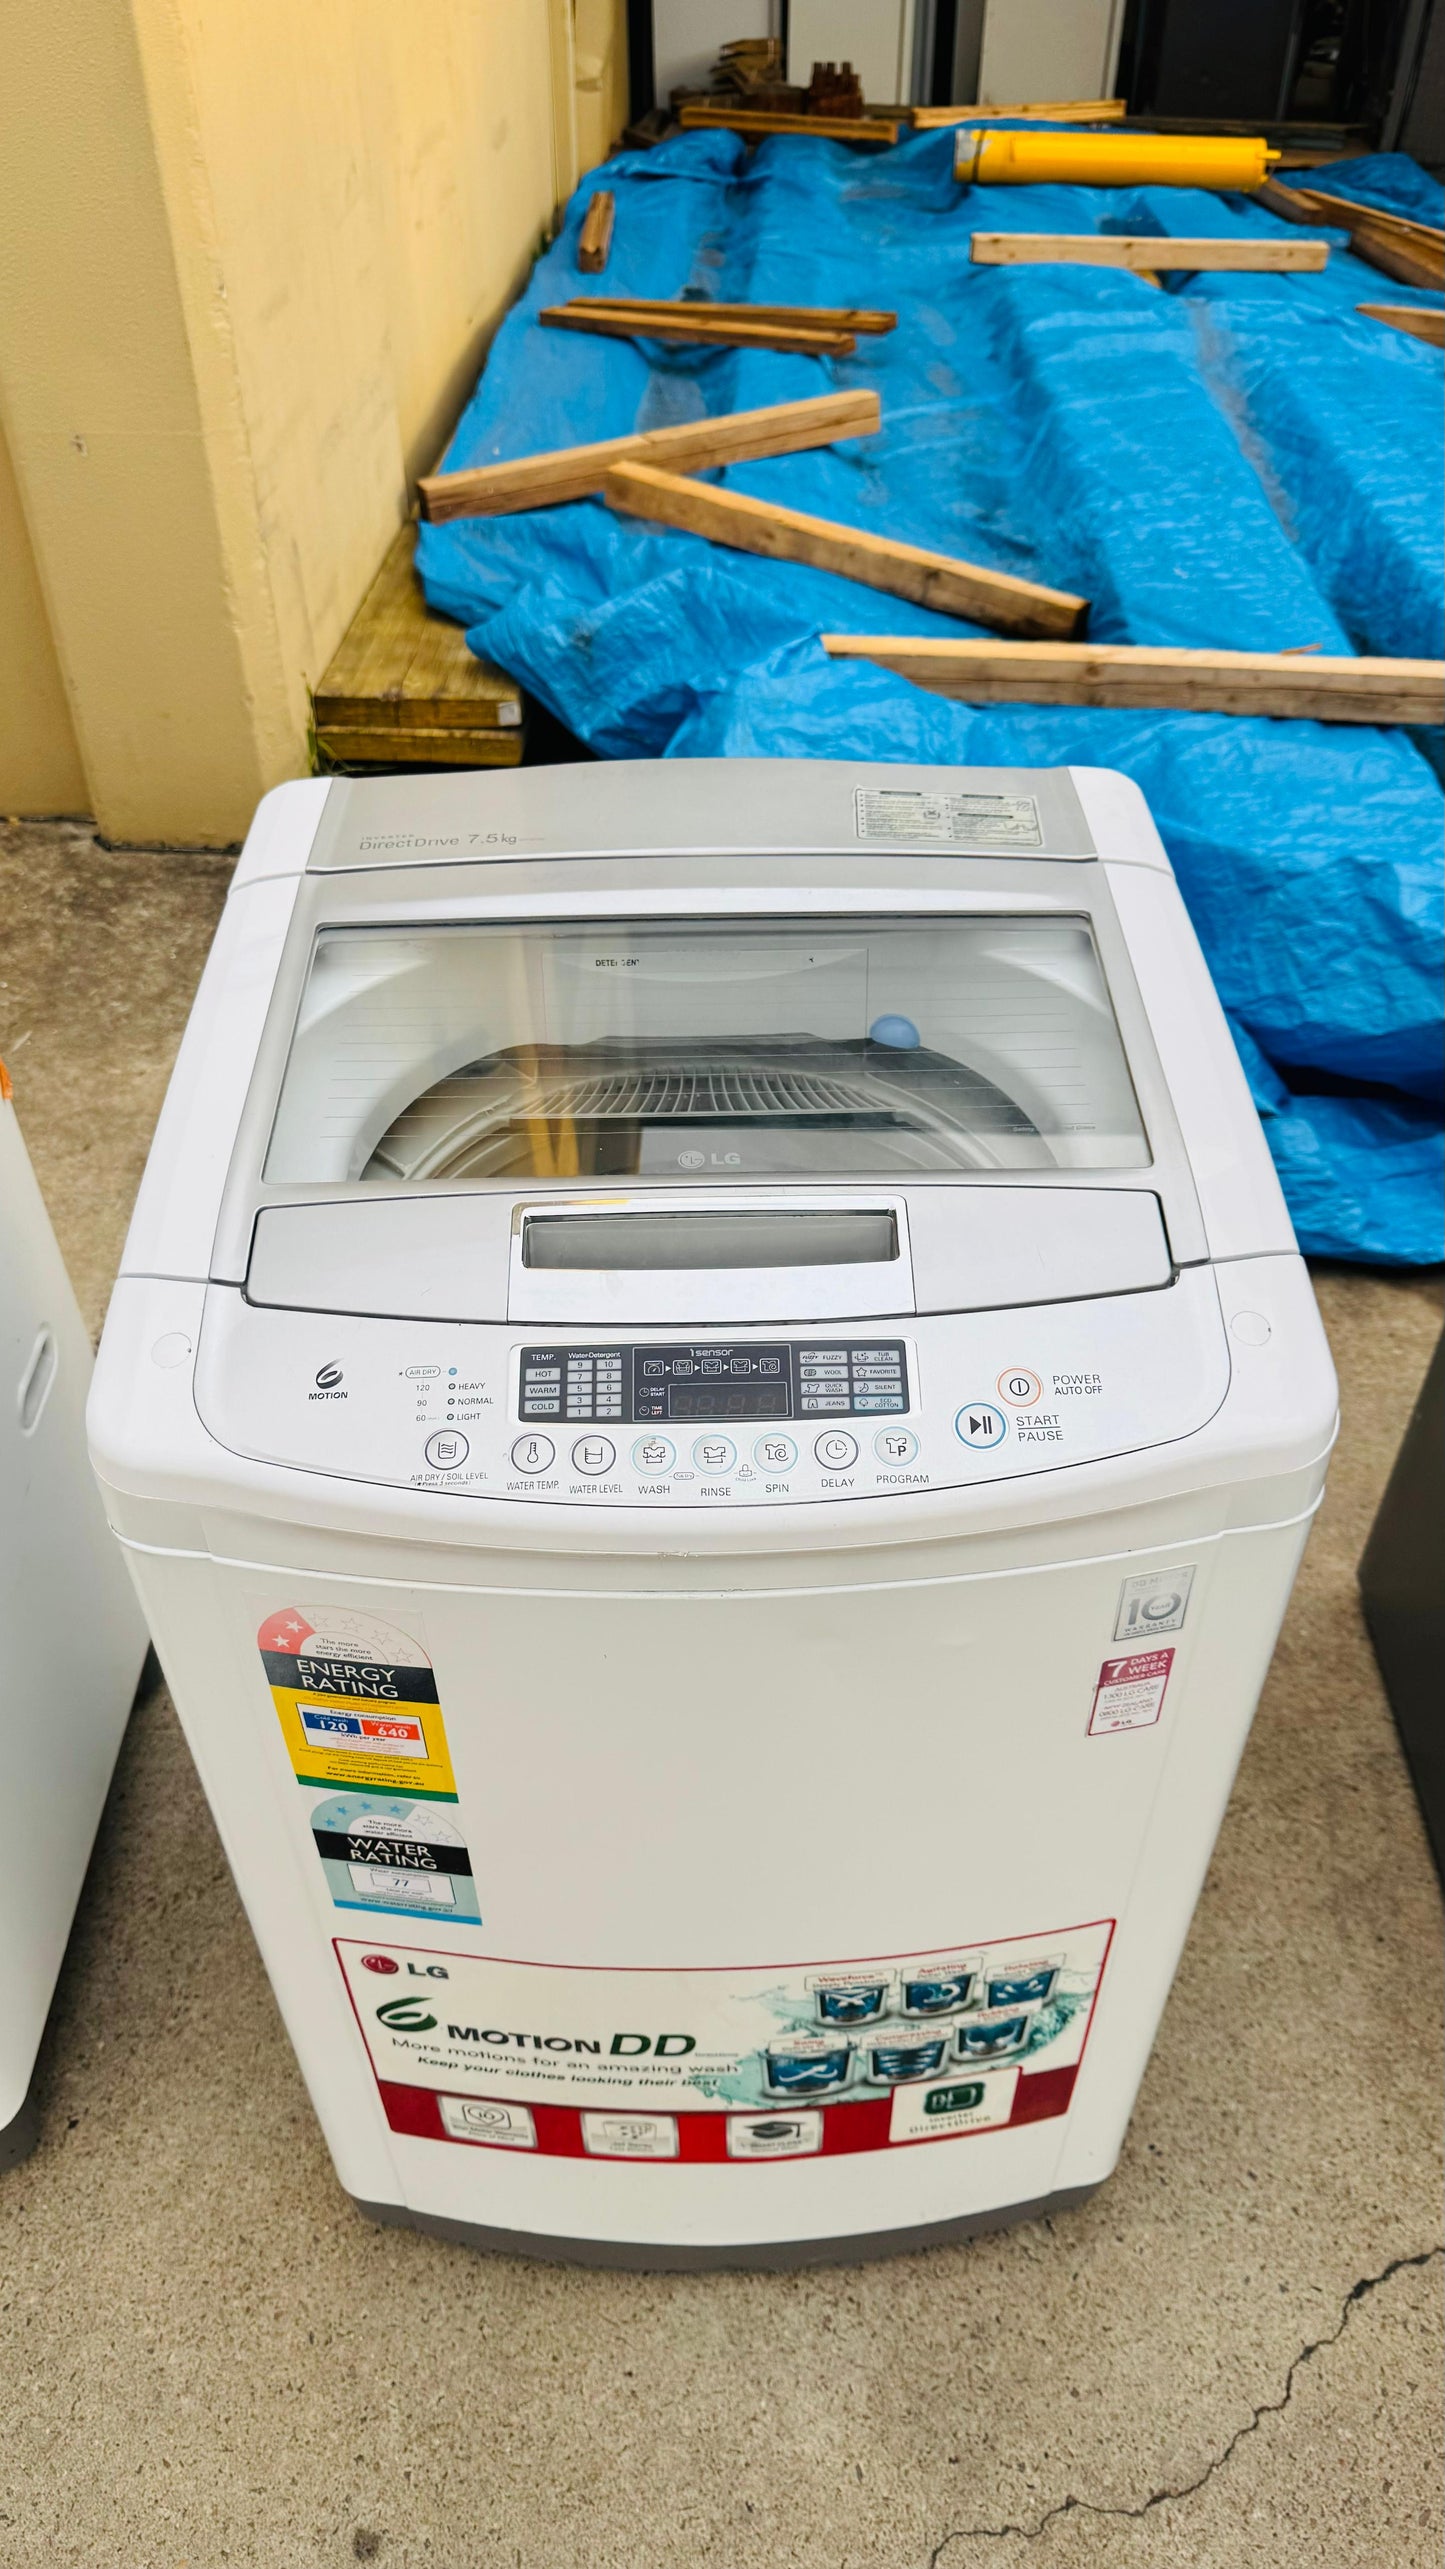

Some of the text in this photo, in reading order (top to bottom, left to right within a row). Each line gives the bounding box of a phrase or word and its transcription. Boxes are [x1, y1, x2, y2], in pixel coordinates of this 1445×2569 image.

[711, 1152, 741, 1165] LG
[577, 1361, 583, 1369] 9
[422, 1368, 437, 1376] DRY
[535, 1370, 553, 1378] HOT
[1052, 1374, 1101, 1385] POWER
[416, 1384, 430, 1392] 120
[458, 1382, 486, 1390] HEAVY
[529, 1387, 557, 1395] WARM
[1054, 1385, 1103, 1395] AUTO OFF
[308, 1391, 348, 1400] MOTION
[417, 1399, 427, 1407] 90
[457, 1397, 494, 1405] NORMAL
[531, 1403, 554, 1411] COLD
[457, 1413, 481, 1421] LIGHT
[1016, 1414, 1060, 1426] START
[1018, 1430, 1064, 1442] PAUSE
[466, 1472, 488, 1480] LEVEL
[876, 1474, 930, 1484] PROGRAM
[506, 1480, 560, 1490] WATER TEMP.
[821, 1478, 855, 1488] DELAY
[569, 1484, 623, 1494] WATER LEVEL
[638, 1485, 671, 1494] WASH
[701, 1487, 732, 1496] RINSE
[765, 1484, 789, 1493] SPIN
[1128, 1592, 1181, 1625] 10
[296, 1659, 396, 1682] ENERGY
[1108, 1660, 1127, 1678] 7
[1130, 1653, 1159, 1665] DAYS
[1128, 1660, 1167, 1674] WEEK
[301, 1676, 399, 1698] RATING
[319, 1721, 348, 1732] 120
[378, 1727, 408, 1738] 640
[347, 1836, 432, 1857] WATER
[350, 1849, 438, 1870] RATING
[392, 1878, 409, 1887] 77
[407, 1962, 449, 1980] LG
[447, 2024, 601, 2054] MOTION
[609, 2033, 696, 2057] DD
[391, 2036, 738, 2076] More motions for an amazing wash
[417, 2055, 459, 2070] Keep
[463, 2063, 501, 2075] your
[505, 2067, 565, 2081] clothes
[571, 2074, 633, 2088] looking
[638, 2077, 677, 2087] their
